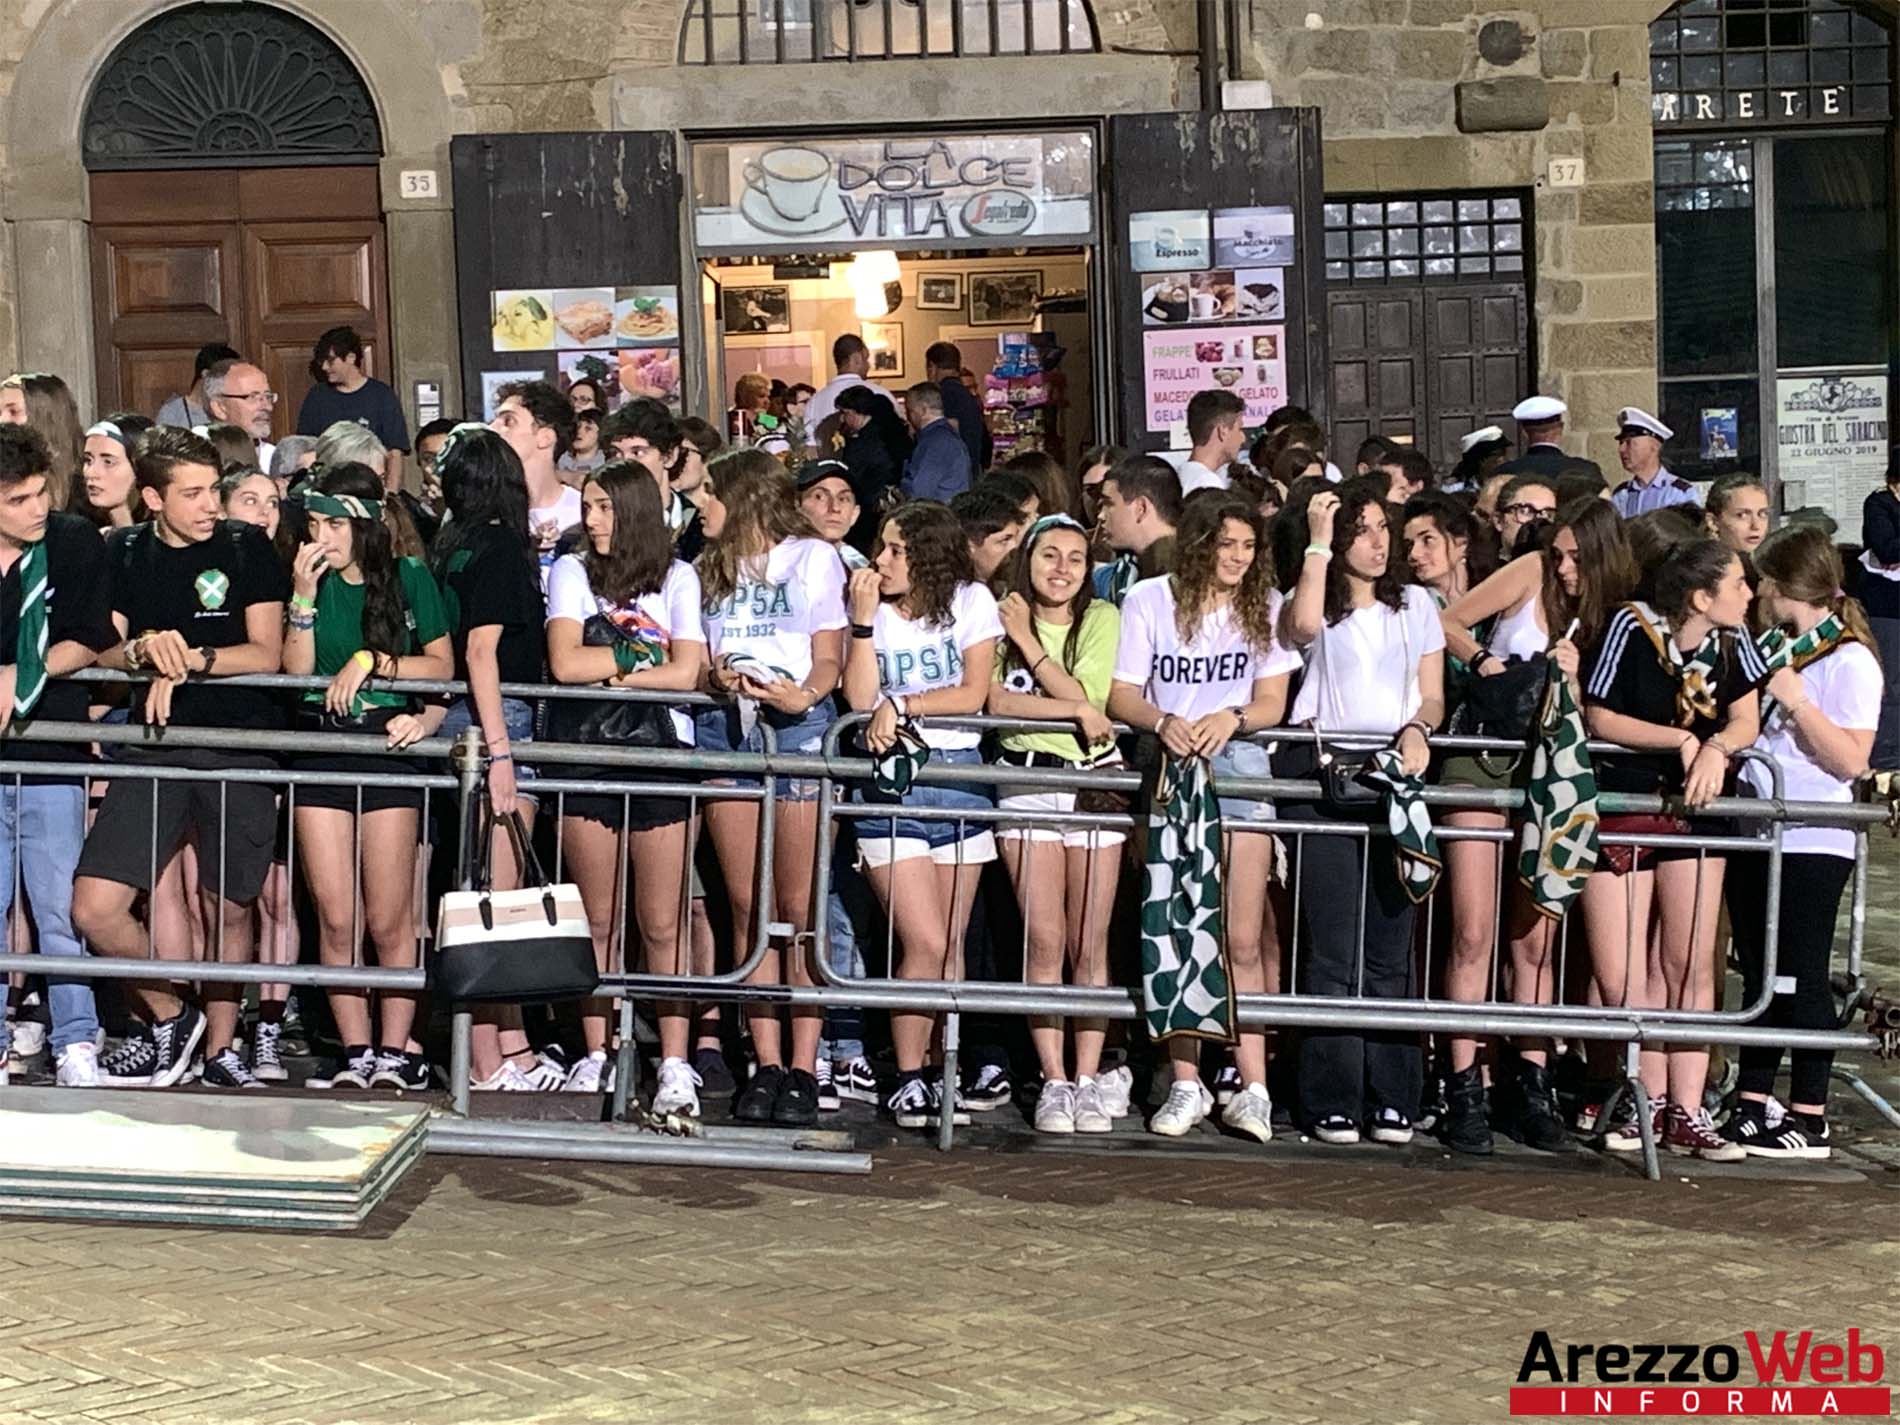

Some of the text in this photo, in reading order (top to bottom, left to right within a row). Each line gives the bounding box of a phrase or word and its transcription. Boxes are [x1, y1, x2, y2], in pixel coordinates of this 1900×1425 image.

[885, 139, 956, 168] LA
[838, 156, 1034, 192] DOLCE
[1554, 164, 1576, 181] 37
[407, 175, 430, 192] 35
[838, 190, 953, 237] VITA
[1155, 248, 1199, 258] Espresso
[1153, 367, 1200, 381] FRULLATI
[1239, 386, 1279, 400] GELATO
[1822, 422, 1839, 443] DEL
[1804, 446, 1852, 457] GIUGNO
[1856, 445, 1878, 455] 2019
[746, 622, 776, 638] 1932
[1151, 652, 1249, 684] FOREVER
